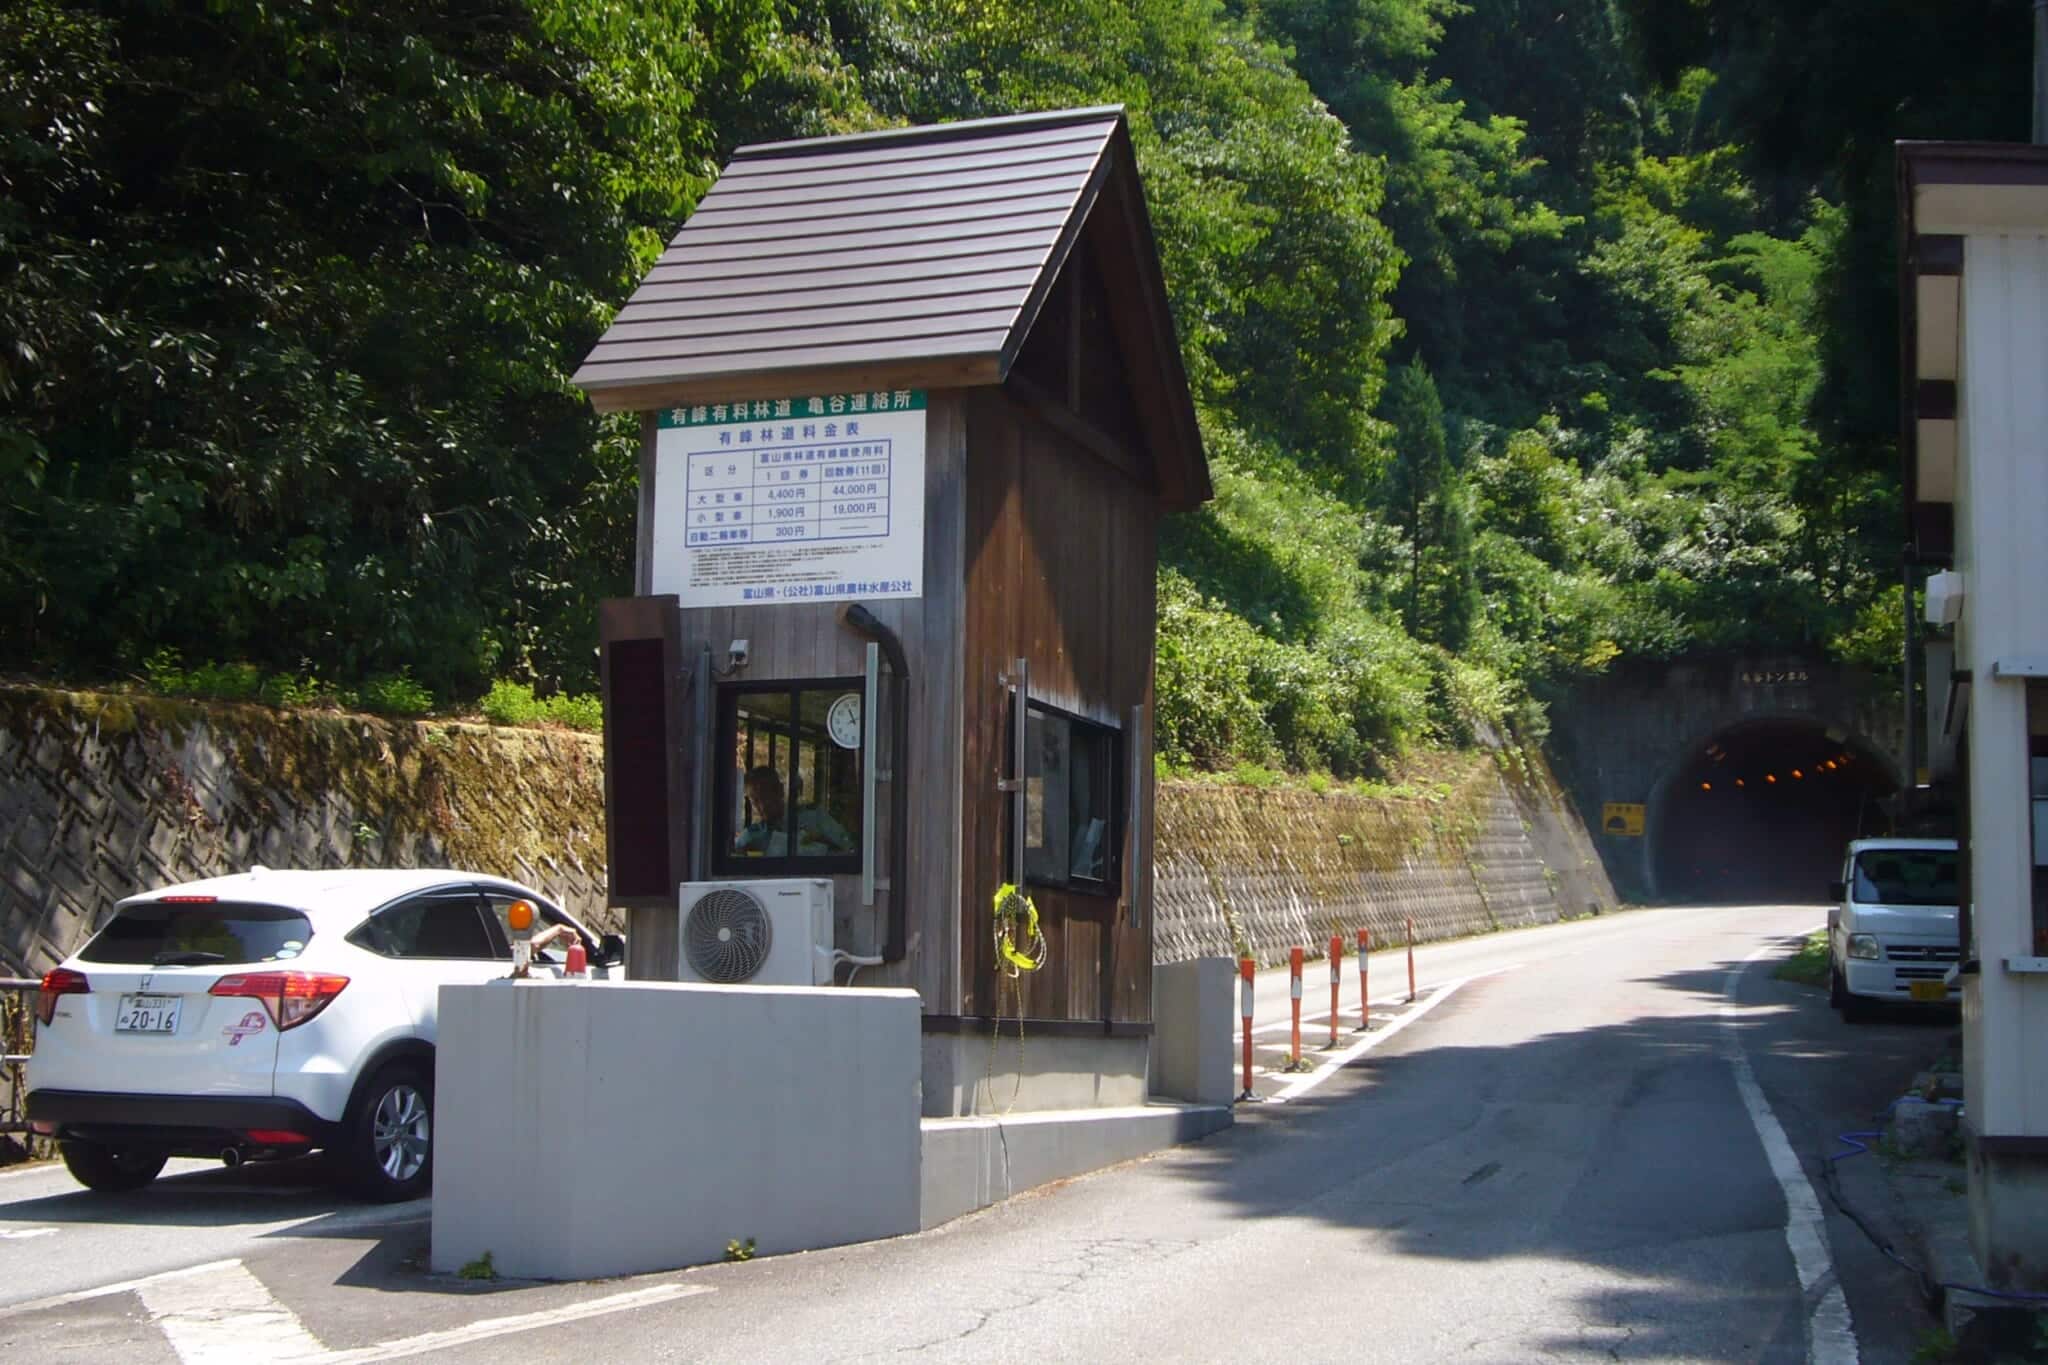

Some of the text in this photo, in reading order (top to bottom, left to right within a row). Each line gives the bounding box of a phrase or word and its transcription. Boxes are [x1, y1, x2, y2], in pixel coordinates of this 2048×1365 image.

[671, 391, 911, 425] 有峰有料林道 亀谷連絡所
[720, 422, 858, 445] 有峰林道料金表
[767, 488, 805, 500] 4,400円
[768, 507, 804, 519] 1,900円
[776, 526, 804, 537] 300円
[1743, 671, 1809, 683] トンネル
[130, 1010, 175, 1029] 20-16
